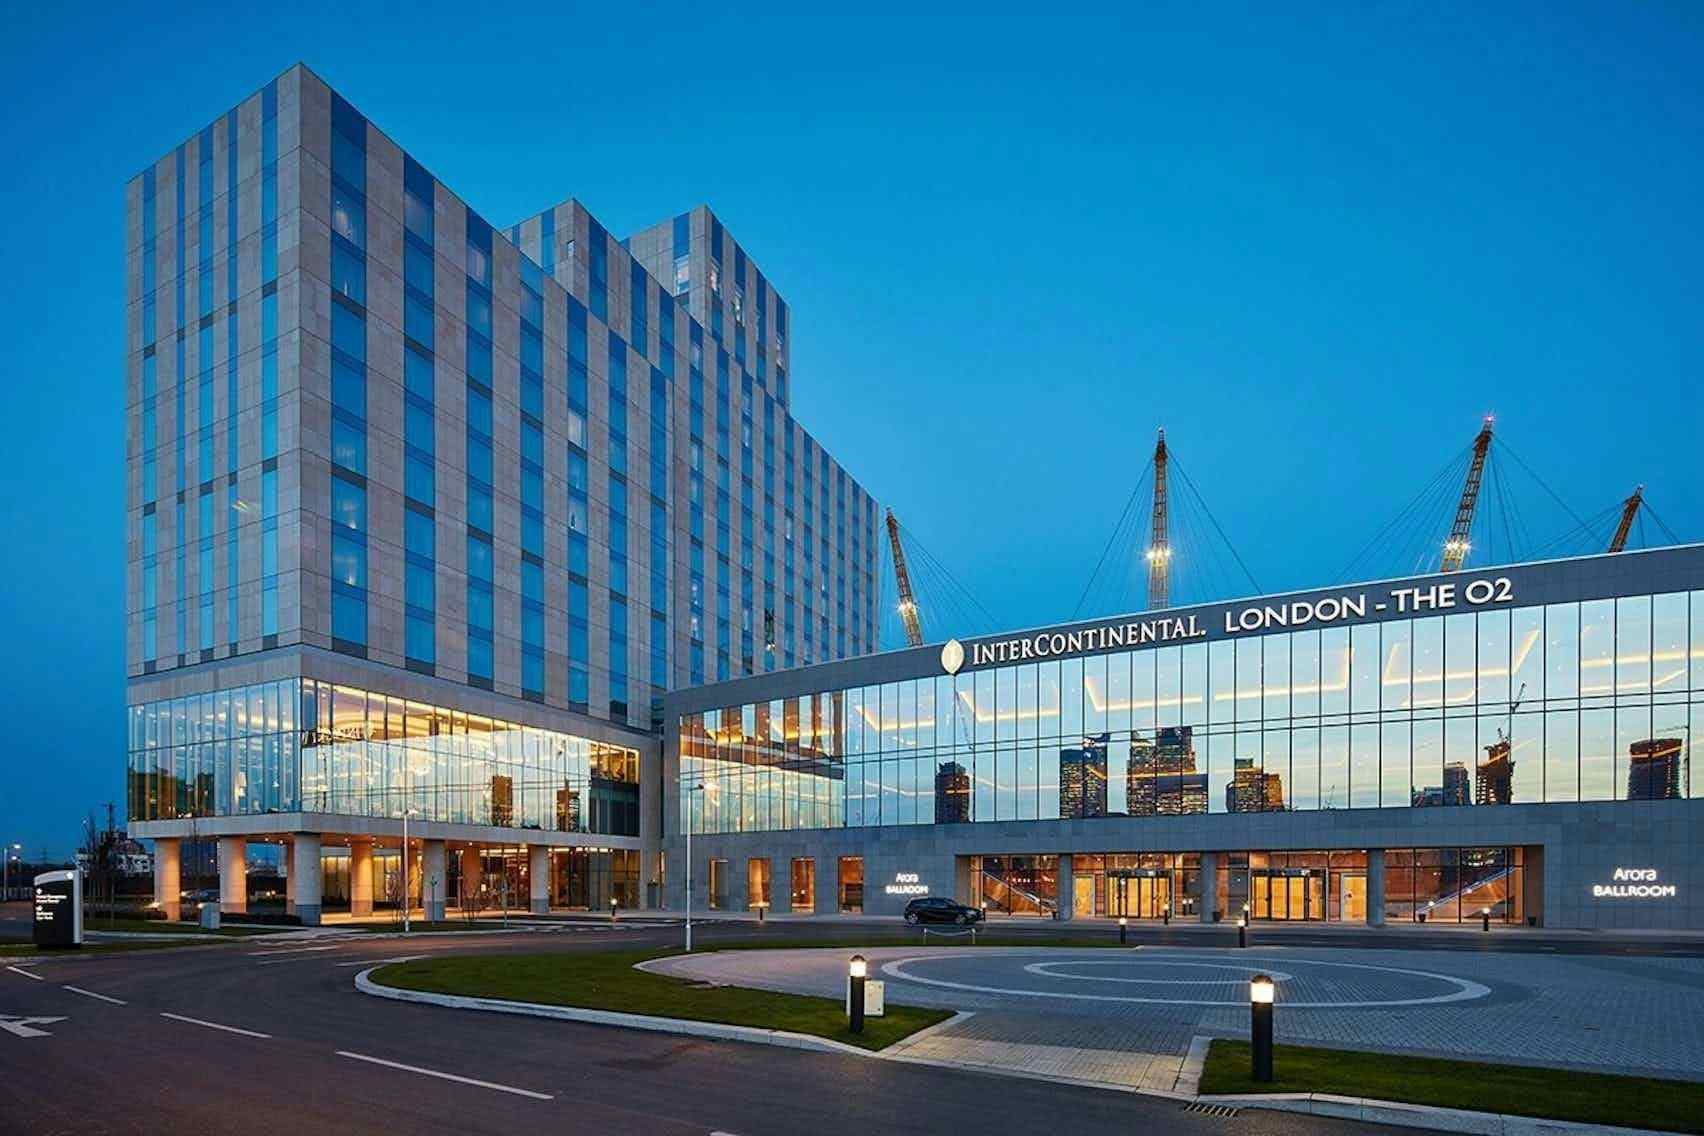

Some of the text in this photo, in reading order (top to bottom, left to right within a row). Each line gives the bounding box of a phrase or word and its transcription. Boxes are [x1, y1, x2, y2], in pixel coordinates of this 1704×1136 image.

[1225, 594, 1366, 633] LONDON
[1391, 583, 1456, 613] THE
[1465, 577, 1514, 604] O2
[1613, 867, 1657, 881] Arora
[885, 885, 929, 894] BALLROOM
[1592, 885, 1676, 897] BALLROOM
